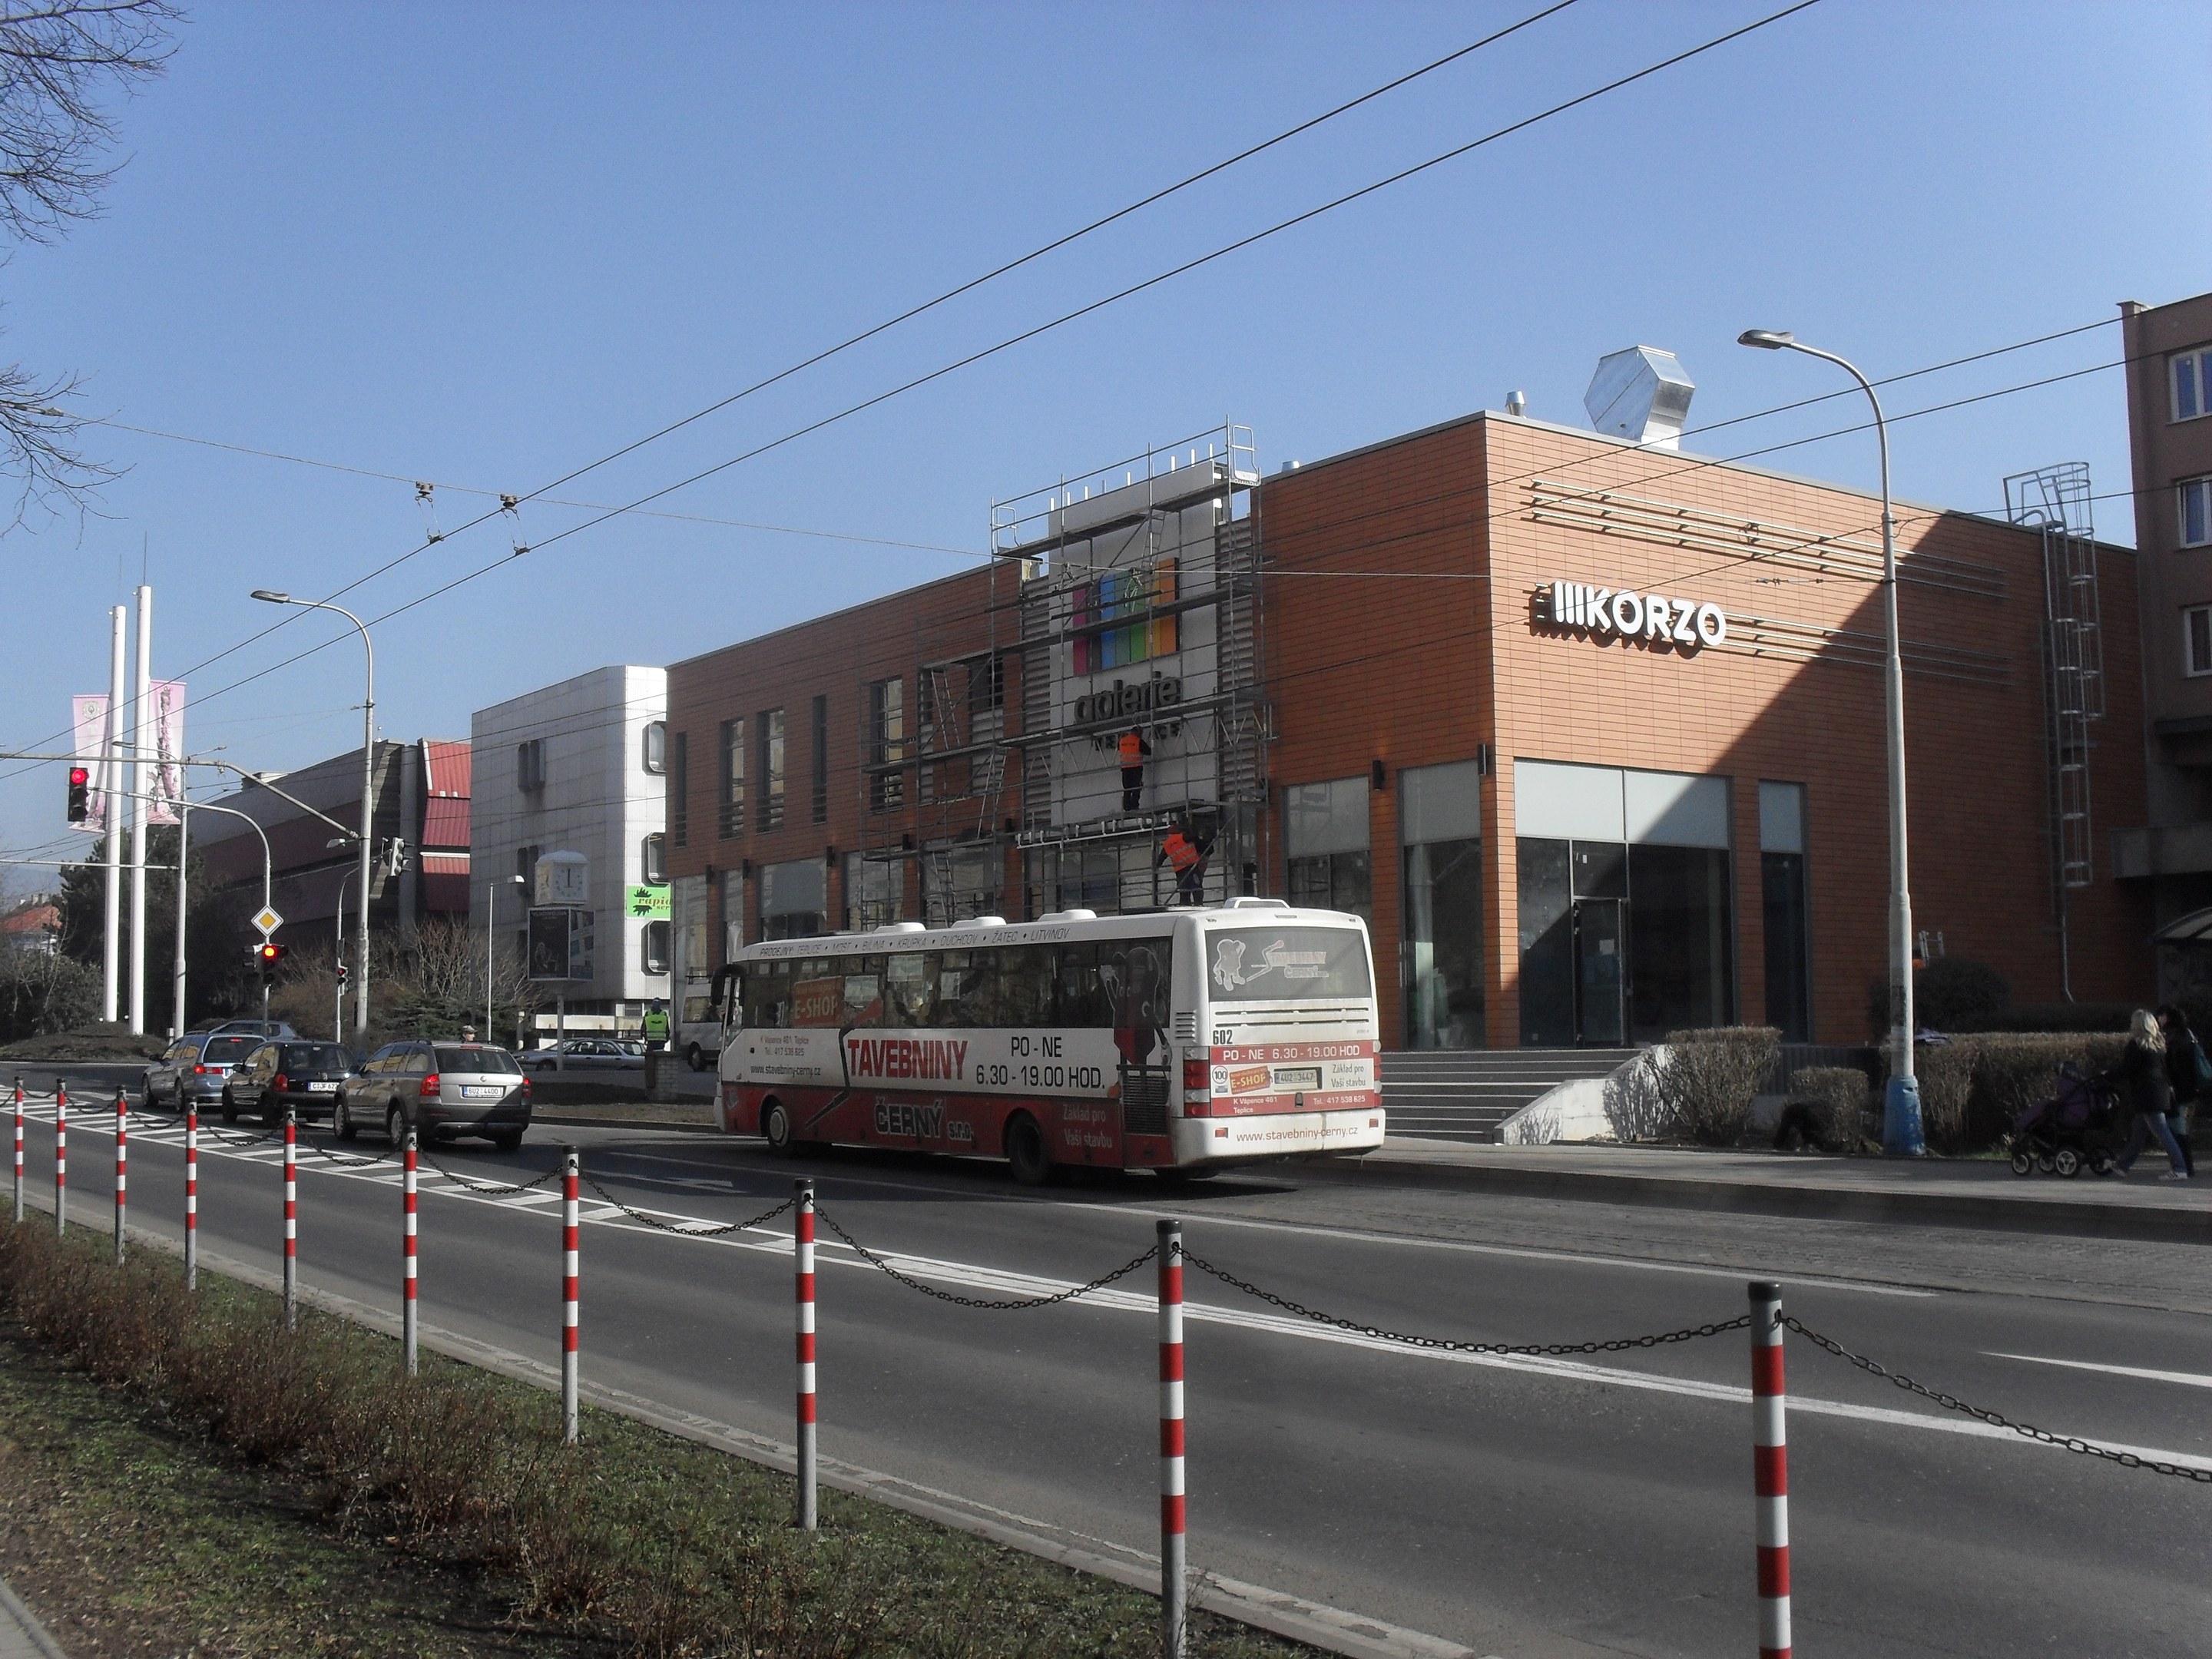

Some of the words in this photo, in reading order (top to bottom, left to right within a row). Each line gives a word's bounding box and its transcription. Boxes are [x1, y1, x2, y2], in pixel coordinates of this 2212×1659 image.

[1585, 584, 1727, 646] KORZO
[794, 995, 838, 1020] E-SHOP
[1213, 1029, 1233, 1045] 602
[1012, 1037, 1030, 1057] PO
[1042, 1037, 1062, 1058] NE
[1224, 1050, 1239, 1061] PO
[1249, 1049, 1264, 1060] NE
[1272, 1048, 1298, 1059] 6.30
[1307, 1046, 1337, 1058] 19.00
[1339, 1045, 1360, 1056] HOD
[976, 1065, 1008, 1085] 6.30
[1021, 1065, 1064, 1087] 19.00
[1068, 1067, 1105, 1088] HOD.
[1215, 1071, 1227, 1080] 100
[1333, 1065, 1353, 1074] Základ
[1354, 1066, 1364, 1075] pro
[1231, 1073, 1266, 1088] E-SHOP
[1331, 1078, 1344, 1088] Vaší
[1346, 1078, 1366, 1087] stavbu
[874, 1096, 944, 1138] ČERNÝ
[1063, 1104, 1090, 1121] Základ
[1092, 1110, 1106, 1125] pro
[1233, 1107, 1253, 1115] Teplice
[1084, 1132, 1112, 1148] stavbu
[1237, 1127, 1358, 1142] www.stavebniny-cerny.cz
